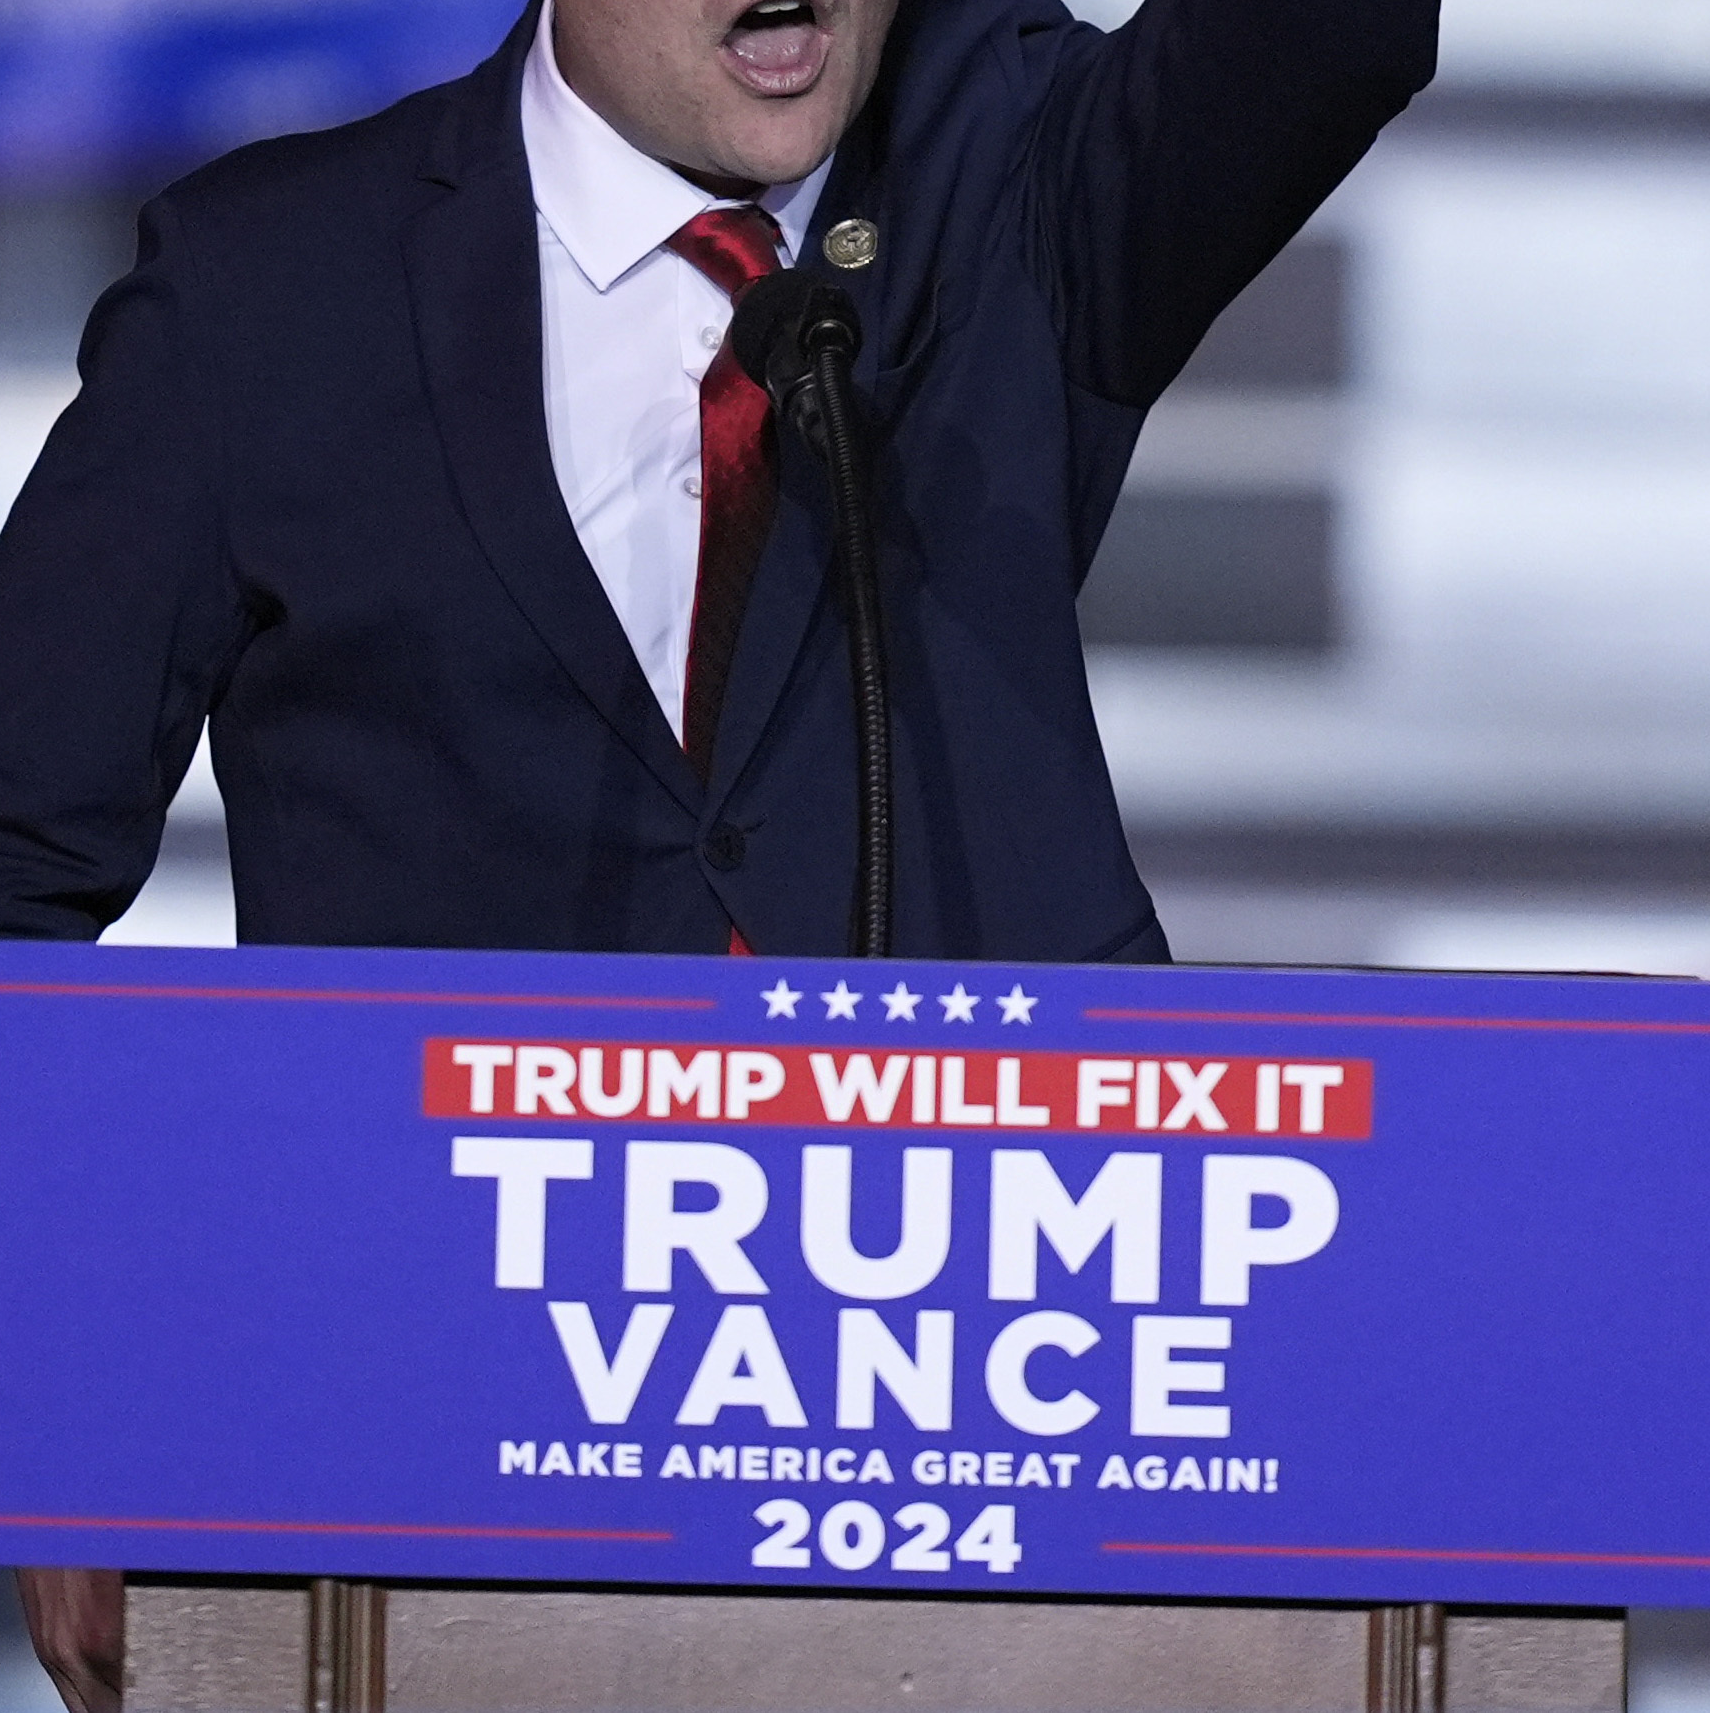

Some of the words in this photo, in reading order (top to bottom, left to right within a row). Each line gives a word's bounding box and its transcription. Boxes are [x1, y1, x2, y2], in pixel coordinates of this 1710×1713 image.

[453, 1044, 786, 1120] TRUMP
[809, 1052, 1051, 1127] WILL
[1076, 1059, 1229, 1131] FIX
[1255, 1063, 1344, 1134] IT
[451, 1136, 1340, 1307] TRUMP
[547, 1300, 1232, 1439] VANCE
[499, 1440, 643, 1478] MAKE
[660, 1444, 894, 1484] AMERICA
[911, 1449, 1081, 1488] GREAT
[1097, 1454, 1279, 1494] AGAIN!
[751, 1498, 1023, 1574] 2024
